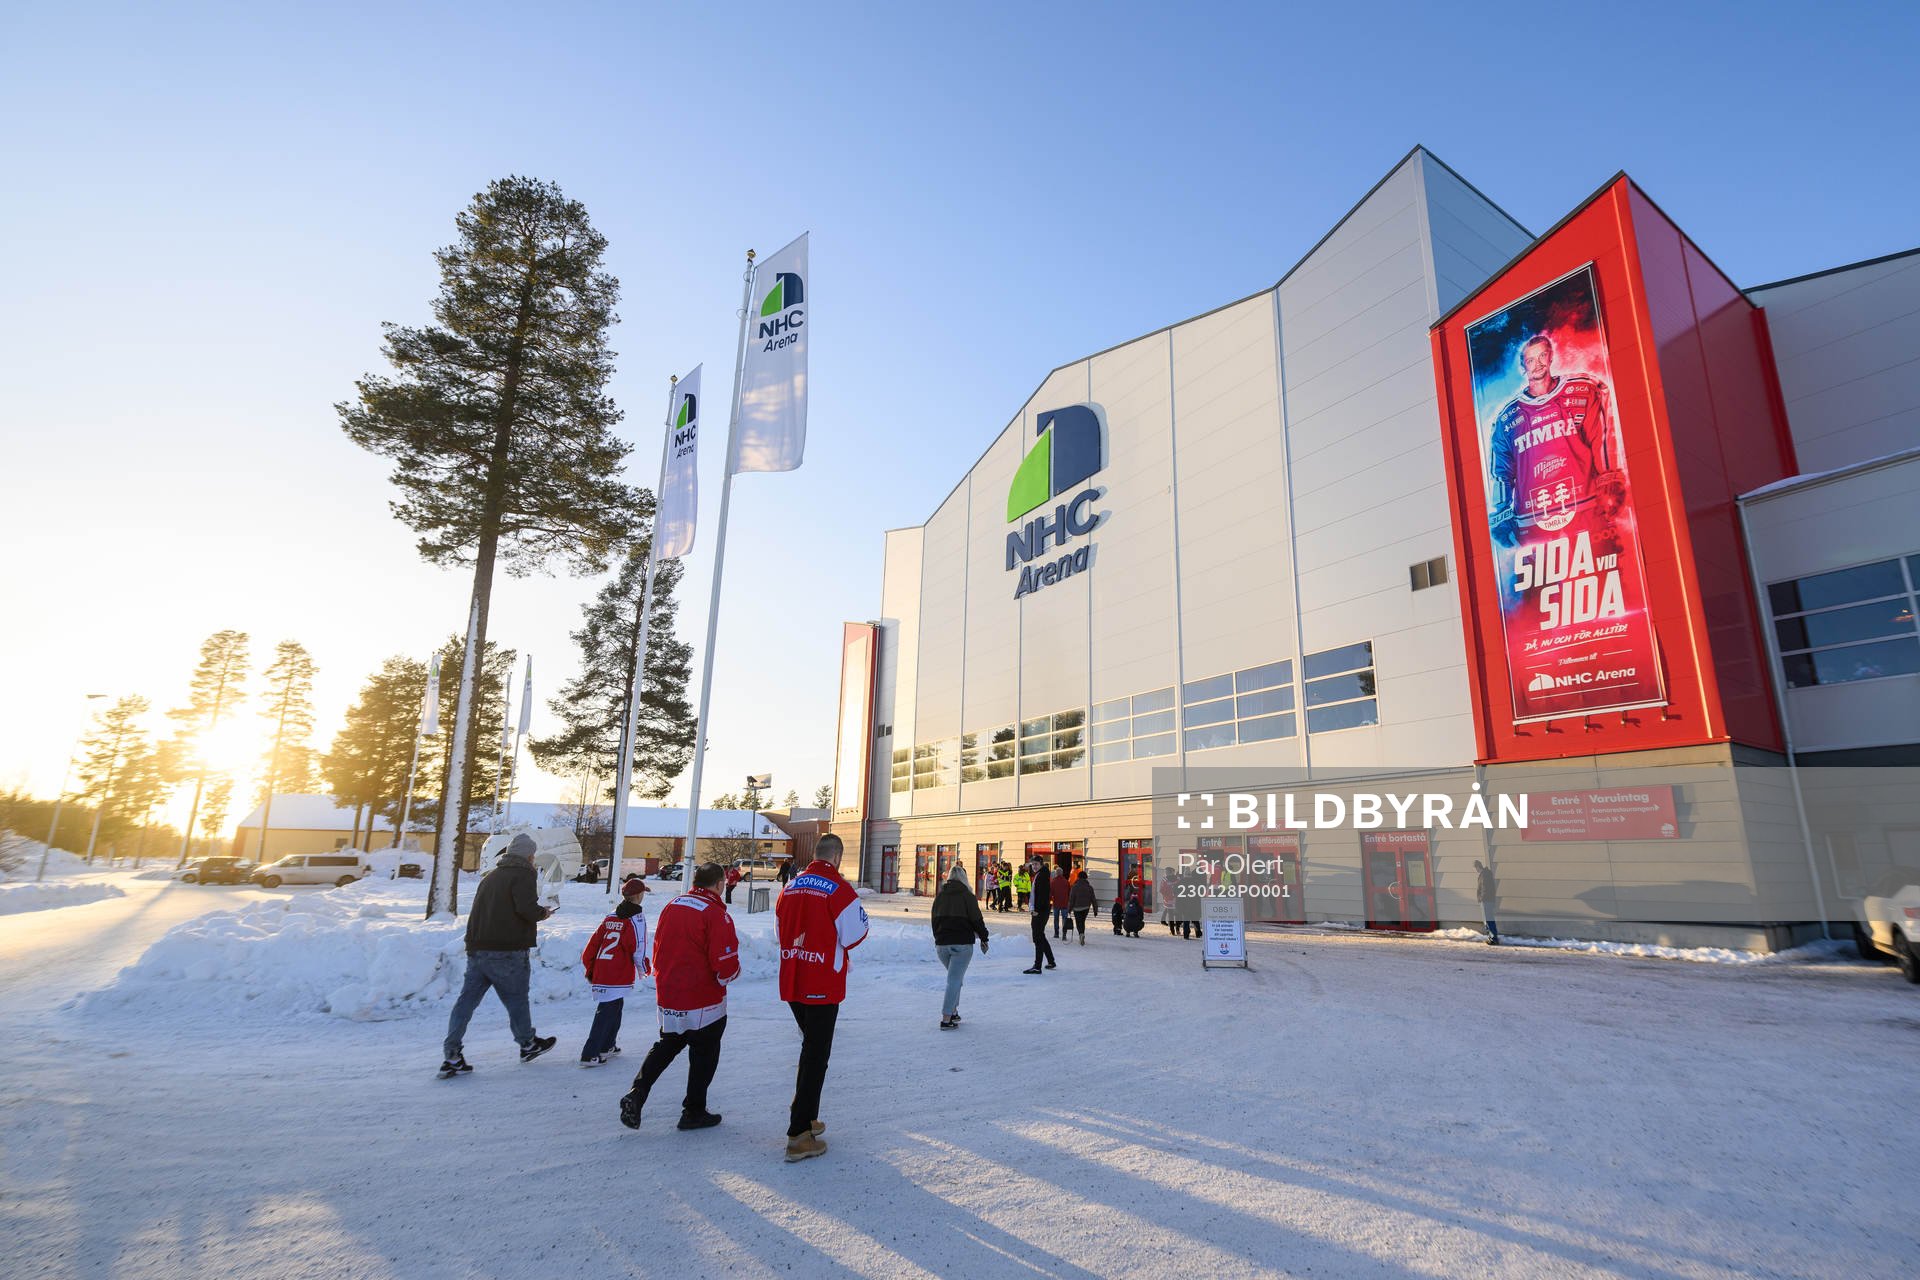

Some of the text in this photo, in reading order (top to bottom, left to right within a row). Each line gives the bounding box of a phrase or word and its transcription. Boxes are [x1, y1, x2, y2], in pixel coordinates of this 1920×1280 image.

[759, 310, 803, 339] NHC
[764, 332, 798, 352] Arena
[674, 424, 696, 448] NHC
[1005, 489, 1100, 572] NHC
[1514, 531, 1617, 592] SIDA VID
[1014, 544, 1090, 600] Arena
[1540, 570, 1625, 631] SIDA
[1541, 639, 1552, 648] NU
[1554, 635, 1571, 644] OCH
[1574, 630, 1592, 640] FÖR
[1555, 667, 1636, 687] NHC Arena
[1552, 796, 1580, 805] Entré
[1589, 792, 1649, 804] Varuintag
[1057, 842, 1071, 850] Entré
[1121, 840, 1138, 849] Entré
[1201, 838, 1222, 847] Entré
[1364, 831, 1426, 843] Entré bortastå
[797, 877, 833, 891] CORVARA
